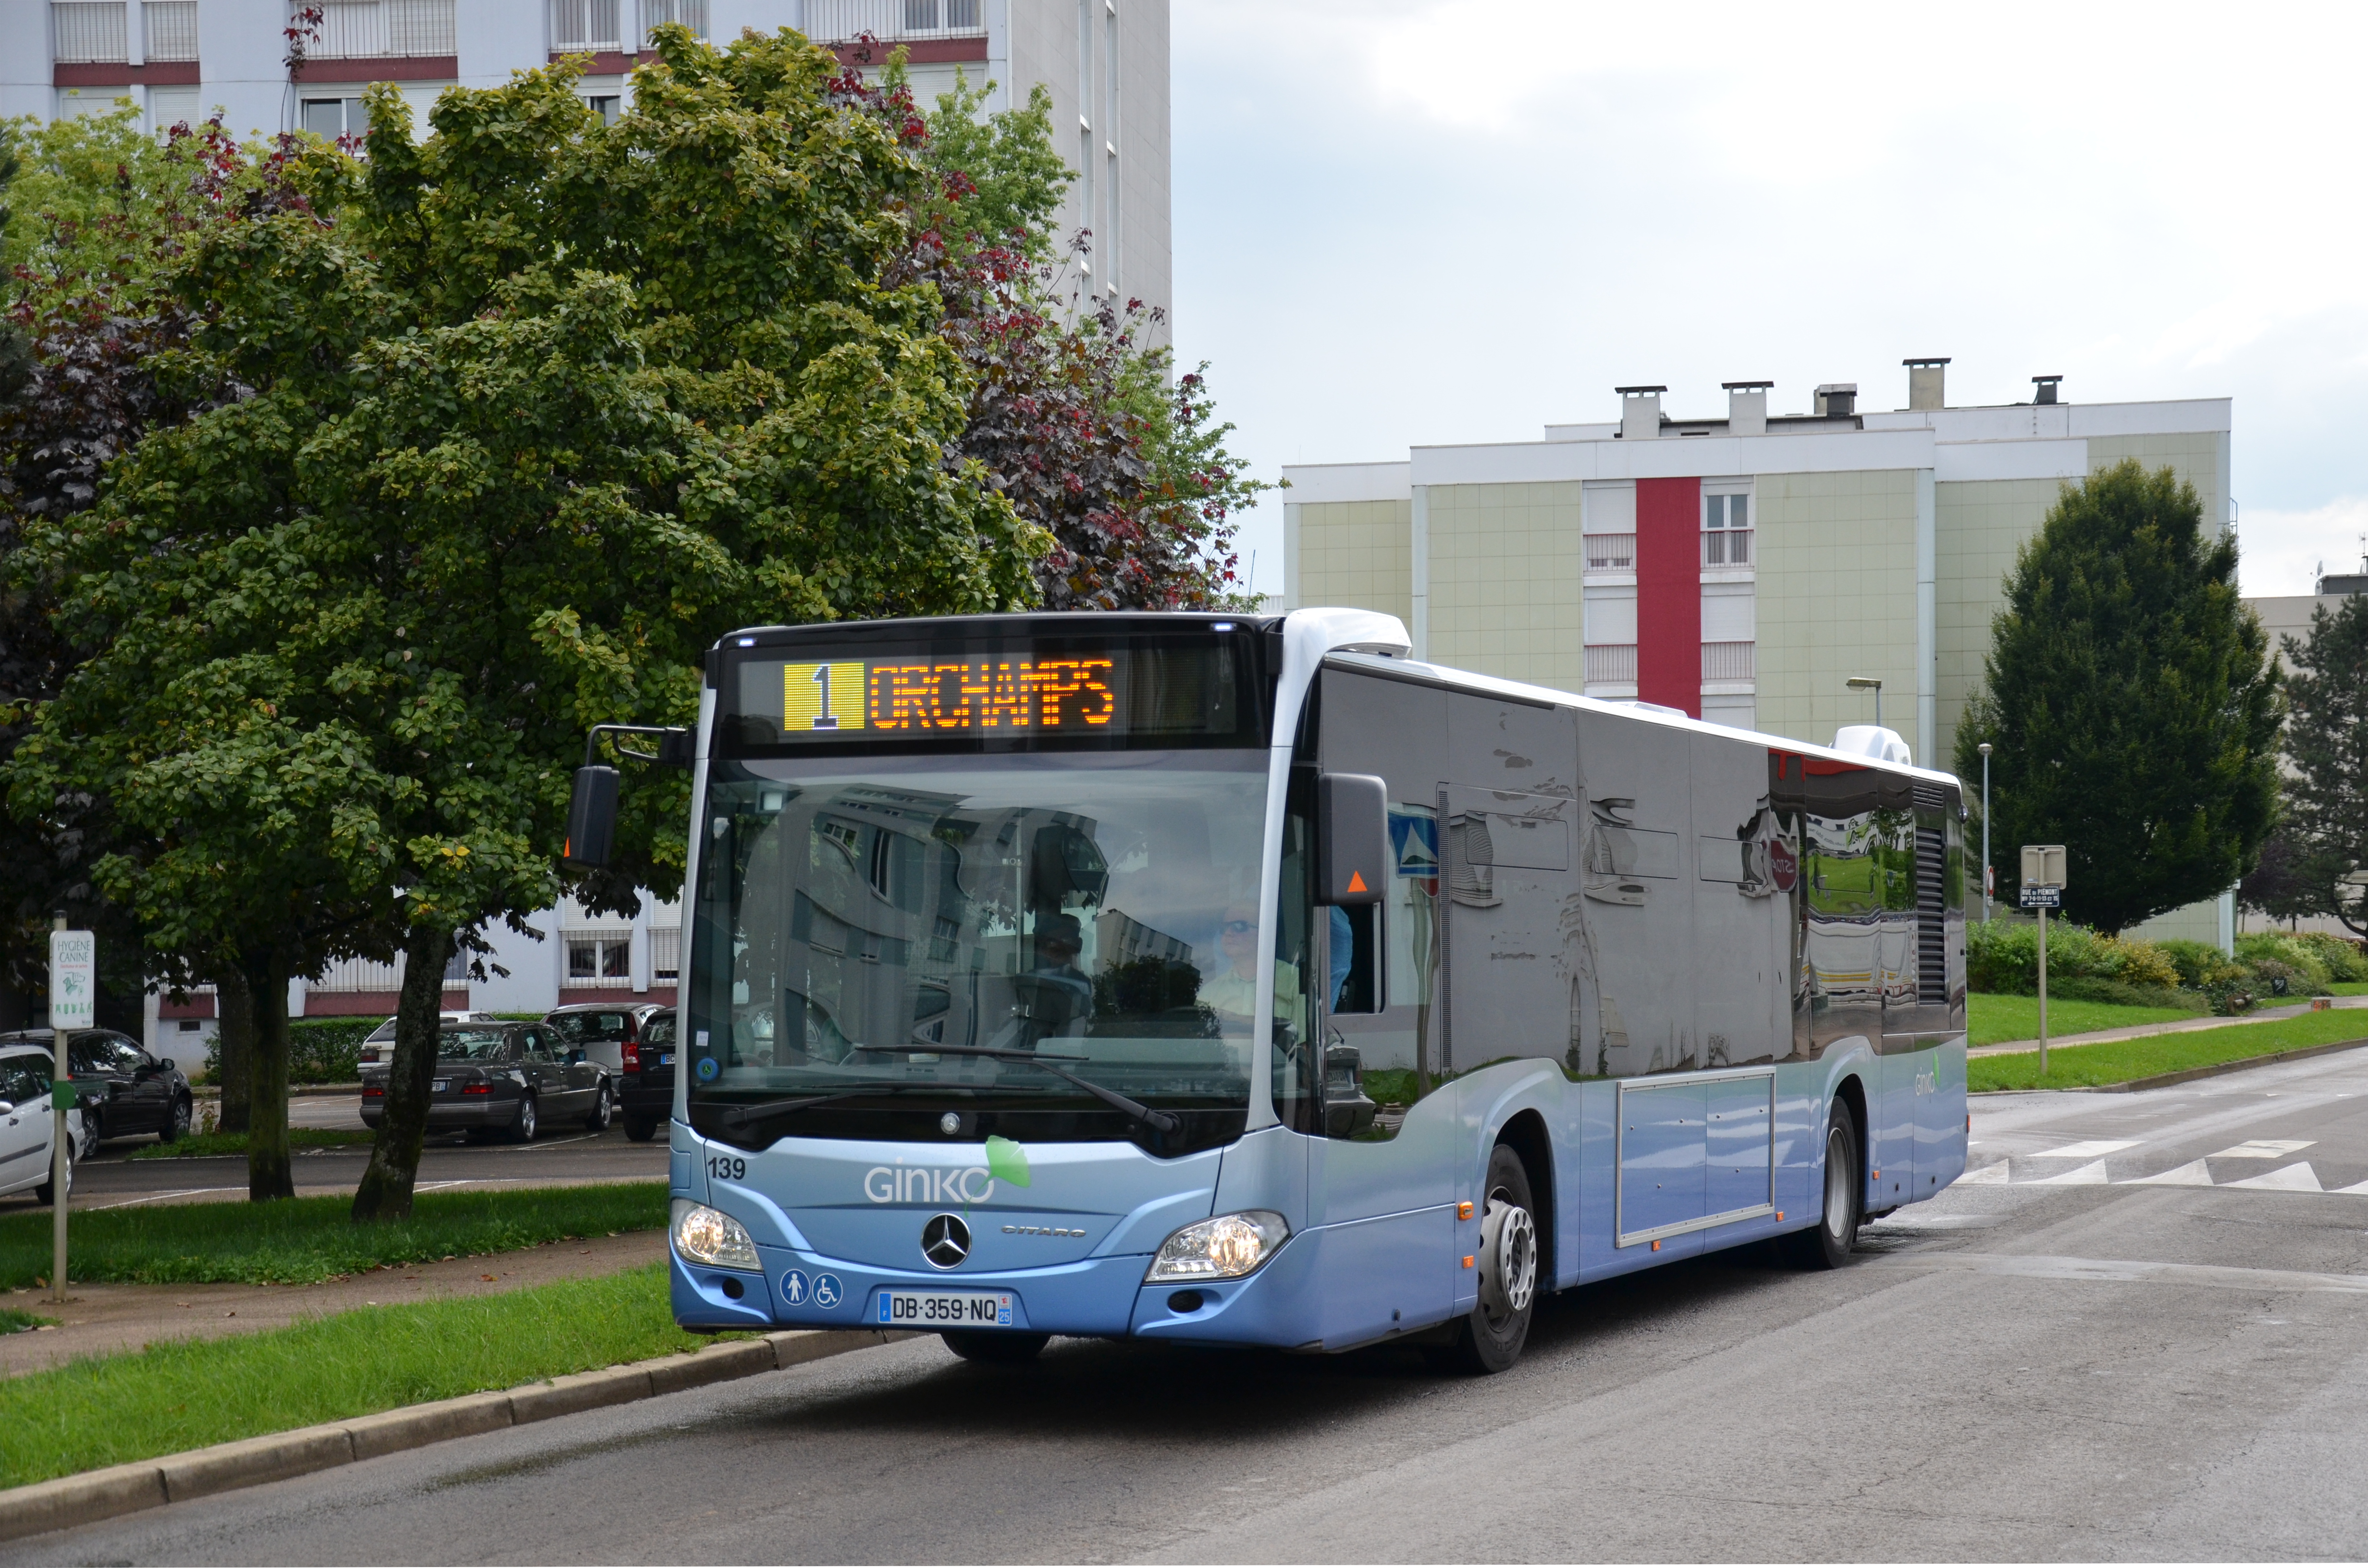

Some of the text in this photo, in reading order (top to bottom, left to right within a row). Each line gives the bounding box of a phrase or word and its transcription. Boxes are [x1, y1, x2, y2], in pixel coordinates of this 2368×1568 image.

[813, 660, 1113, 730] 1 ORCHAMPS
[58, 937, 90, 951] HYGIÈNE
[60, 952, 88, 963] CANINE
[708, 1157, 746, 1180] 139
[1001, 1225, 1086, 1237] CITARO
[893, 1298, 997, 1321] DB-359-NQ
[999, 1311, 1010, 1322] 25
